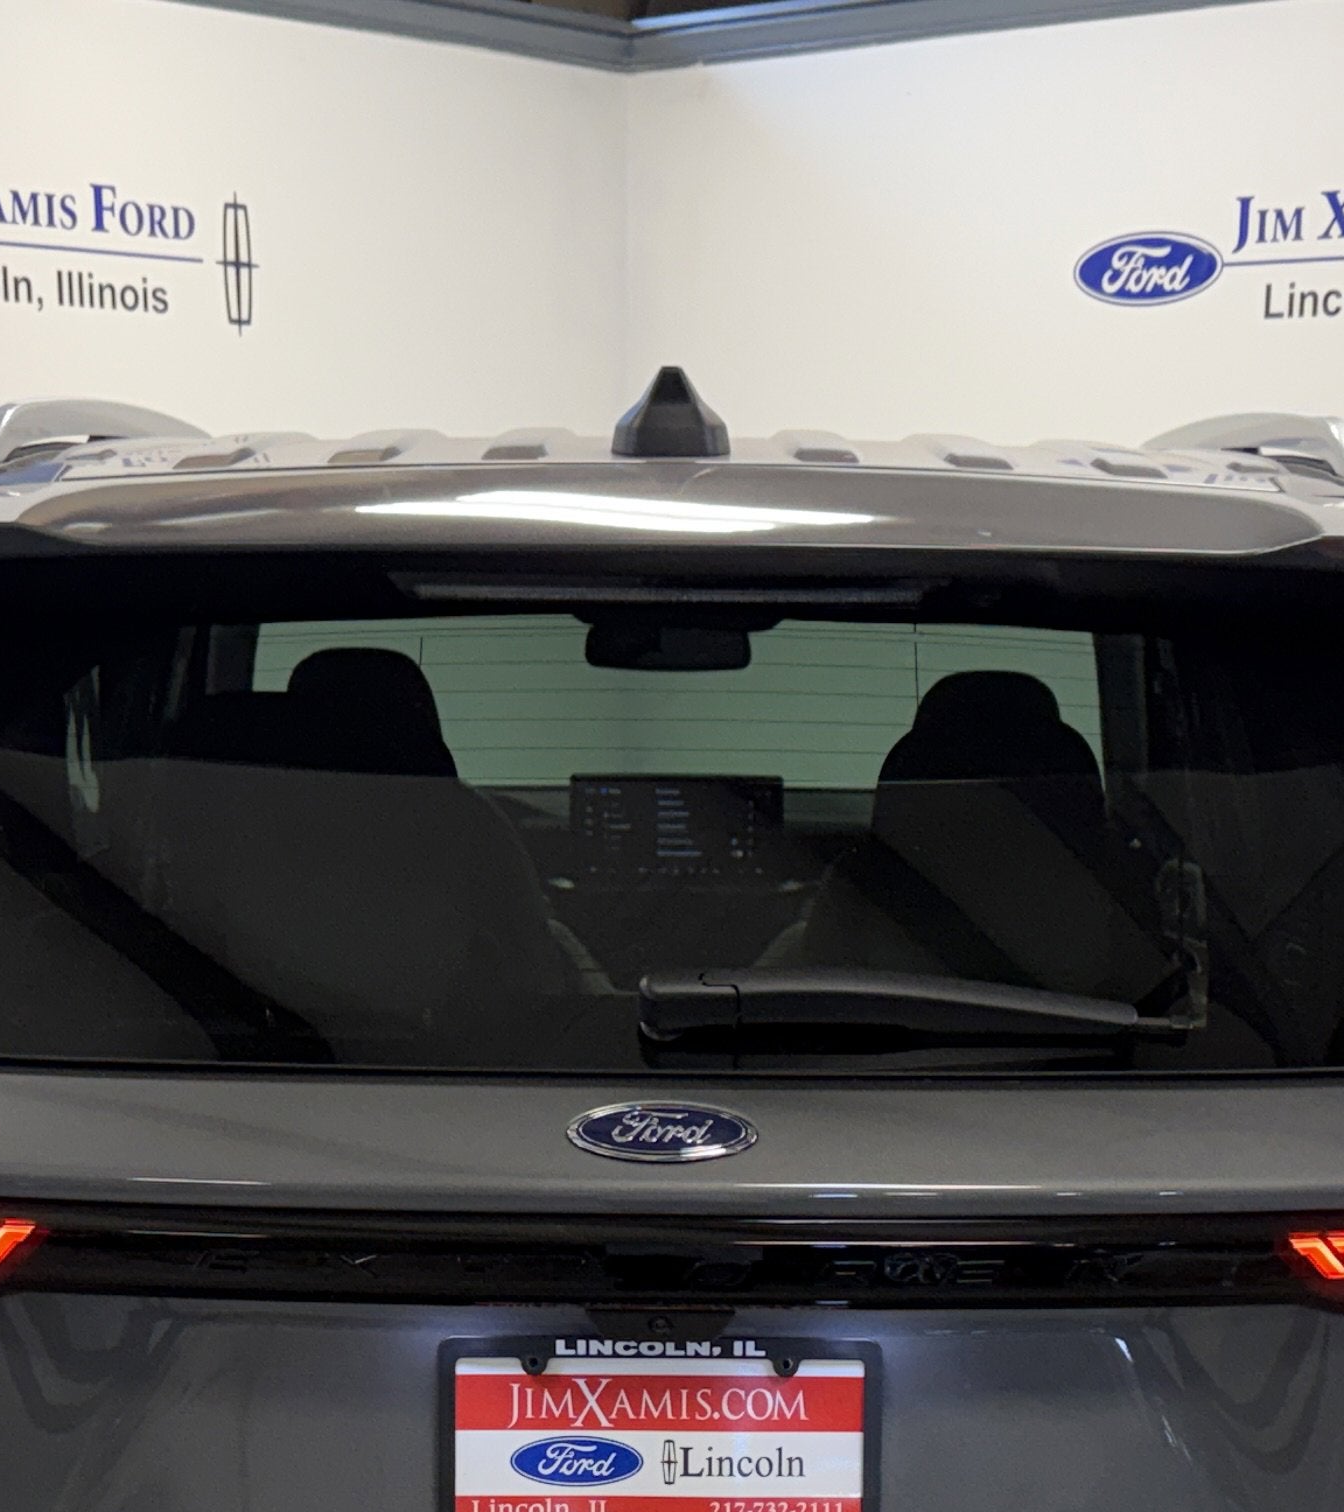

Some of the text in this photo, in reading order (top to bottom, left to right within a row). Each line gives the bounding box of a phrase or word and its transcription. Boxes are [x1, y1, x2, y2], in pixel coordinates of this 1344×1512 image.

[90, 184, 196, 241] FORD
[1232, 196, 1304, 253] JIM
[1101, 244, 1191, 294] Ford
[56, 269, 169, 314] Illinois
[611, 1111, 714, 1145] Ford
[555, 1339, 766, 1357] LINCOLN, IL
[538, 1438, 615, 1478] Ford
[679, 1446, 806, 1479] Lincoln
